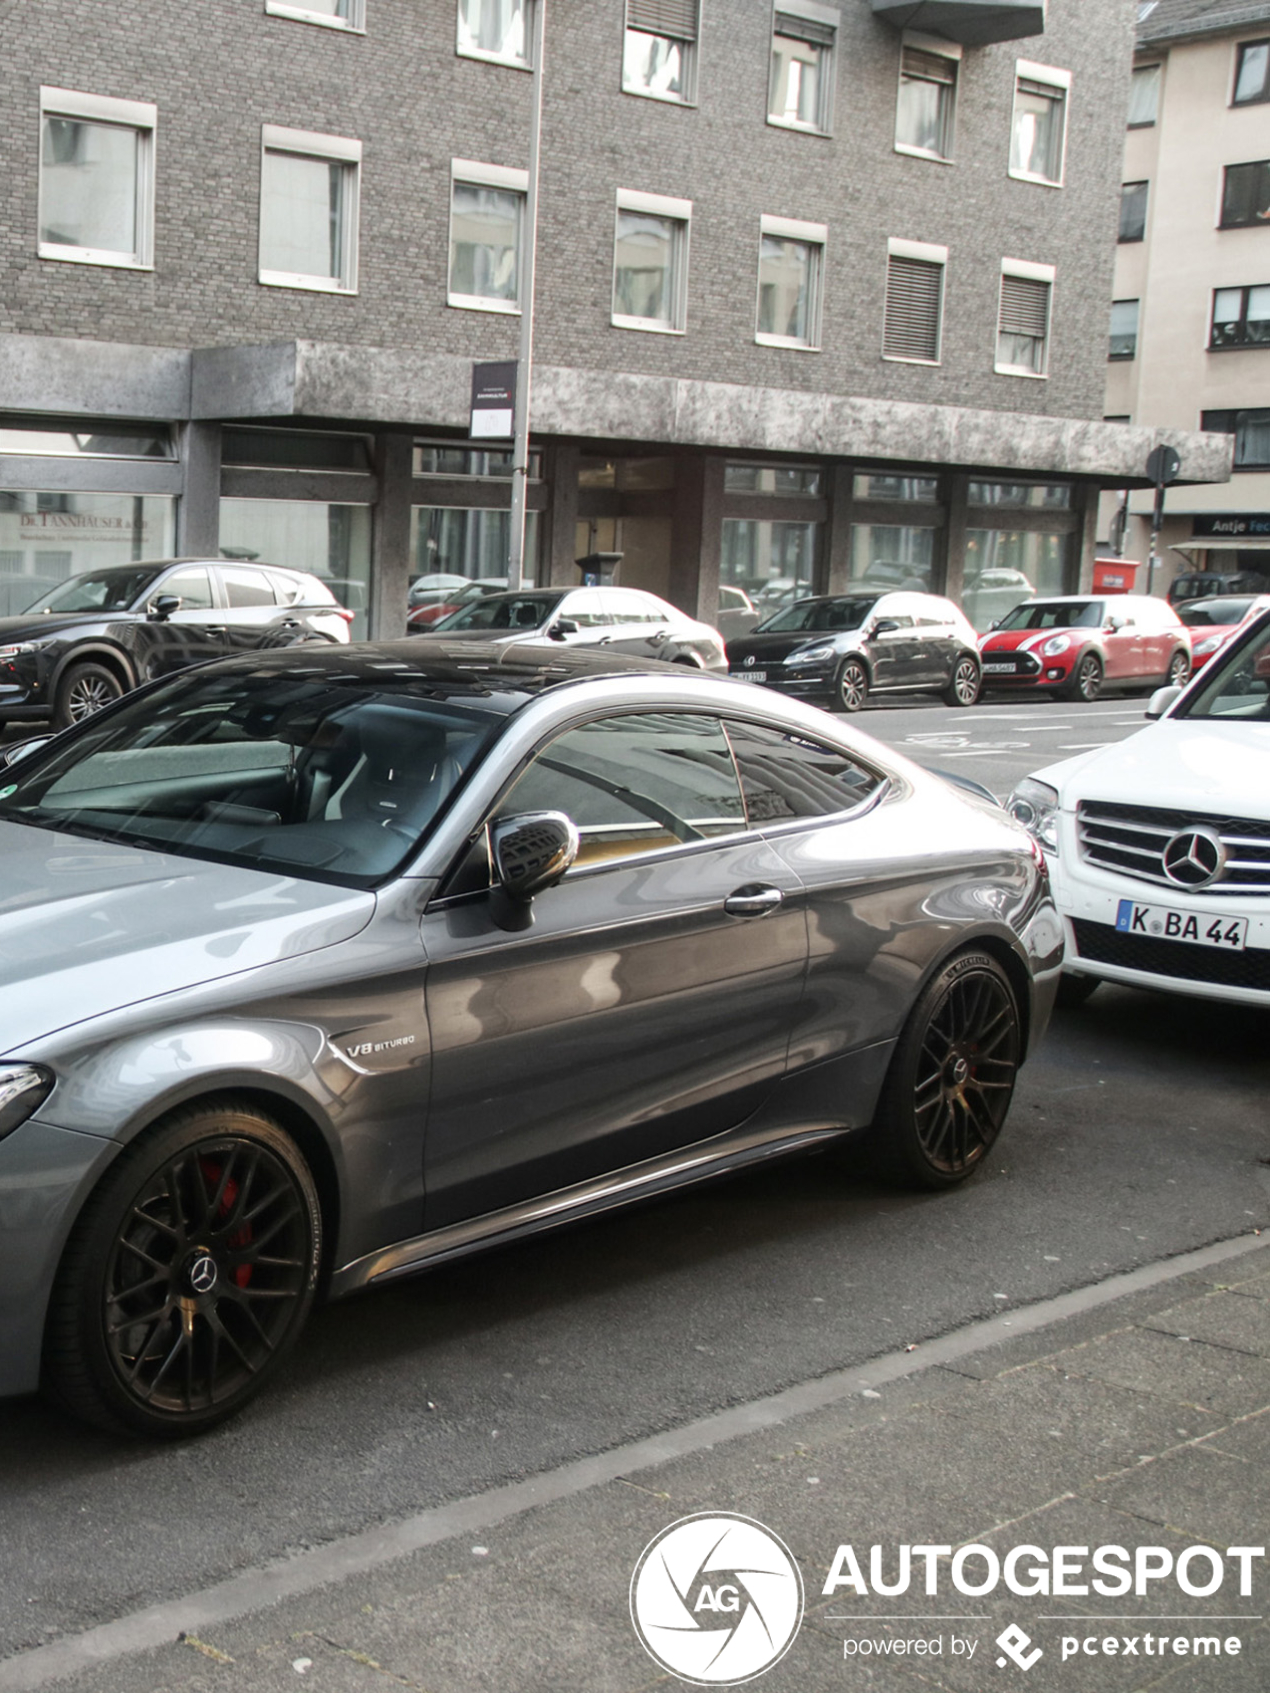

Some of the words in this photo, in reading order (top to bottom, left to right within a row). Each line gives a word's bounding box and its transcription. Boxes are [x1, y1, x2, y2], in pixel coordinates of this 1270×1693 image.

[1212, 520, 1246, 534] Antje
[1132, 906, 1150, 932] K
[1164, 912, 1199, 940] BA
[1206, 919, 1241, 946] 44
[347, 1042, 373, 1058] V8
[374, 1035, 415, 1052] BITURBO
